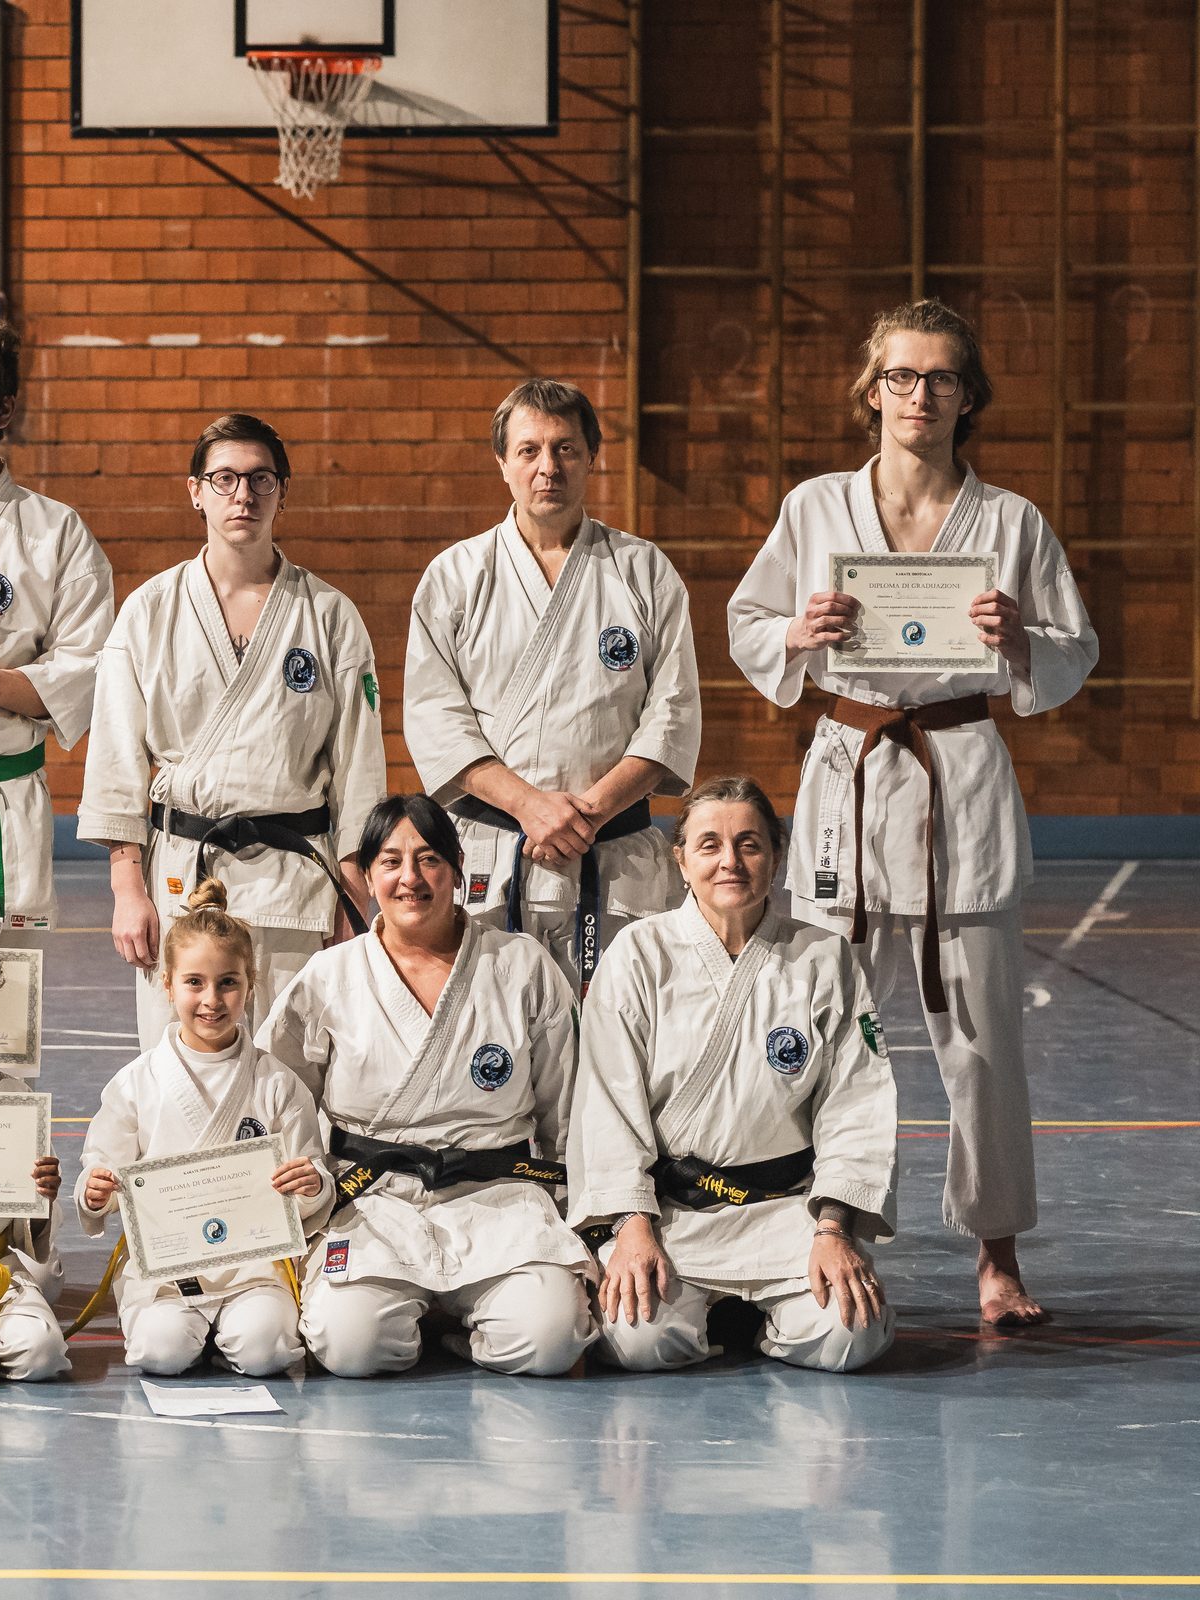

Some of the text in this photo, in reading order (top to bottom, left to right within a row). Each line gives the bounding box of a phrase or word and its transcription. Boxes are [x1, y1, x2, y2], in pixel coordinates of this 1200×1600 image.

[820, 827, 834, 869] 空手道
[584, 913, 595, 970] OSCAR
[159, 1182, 191, 1194] DIPLOMA
[192, 1179, 201, 1187] DI
